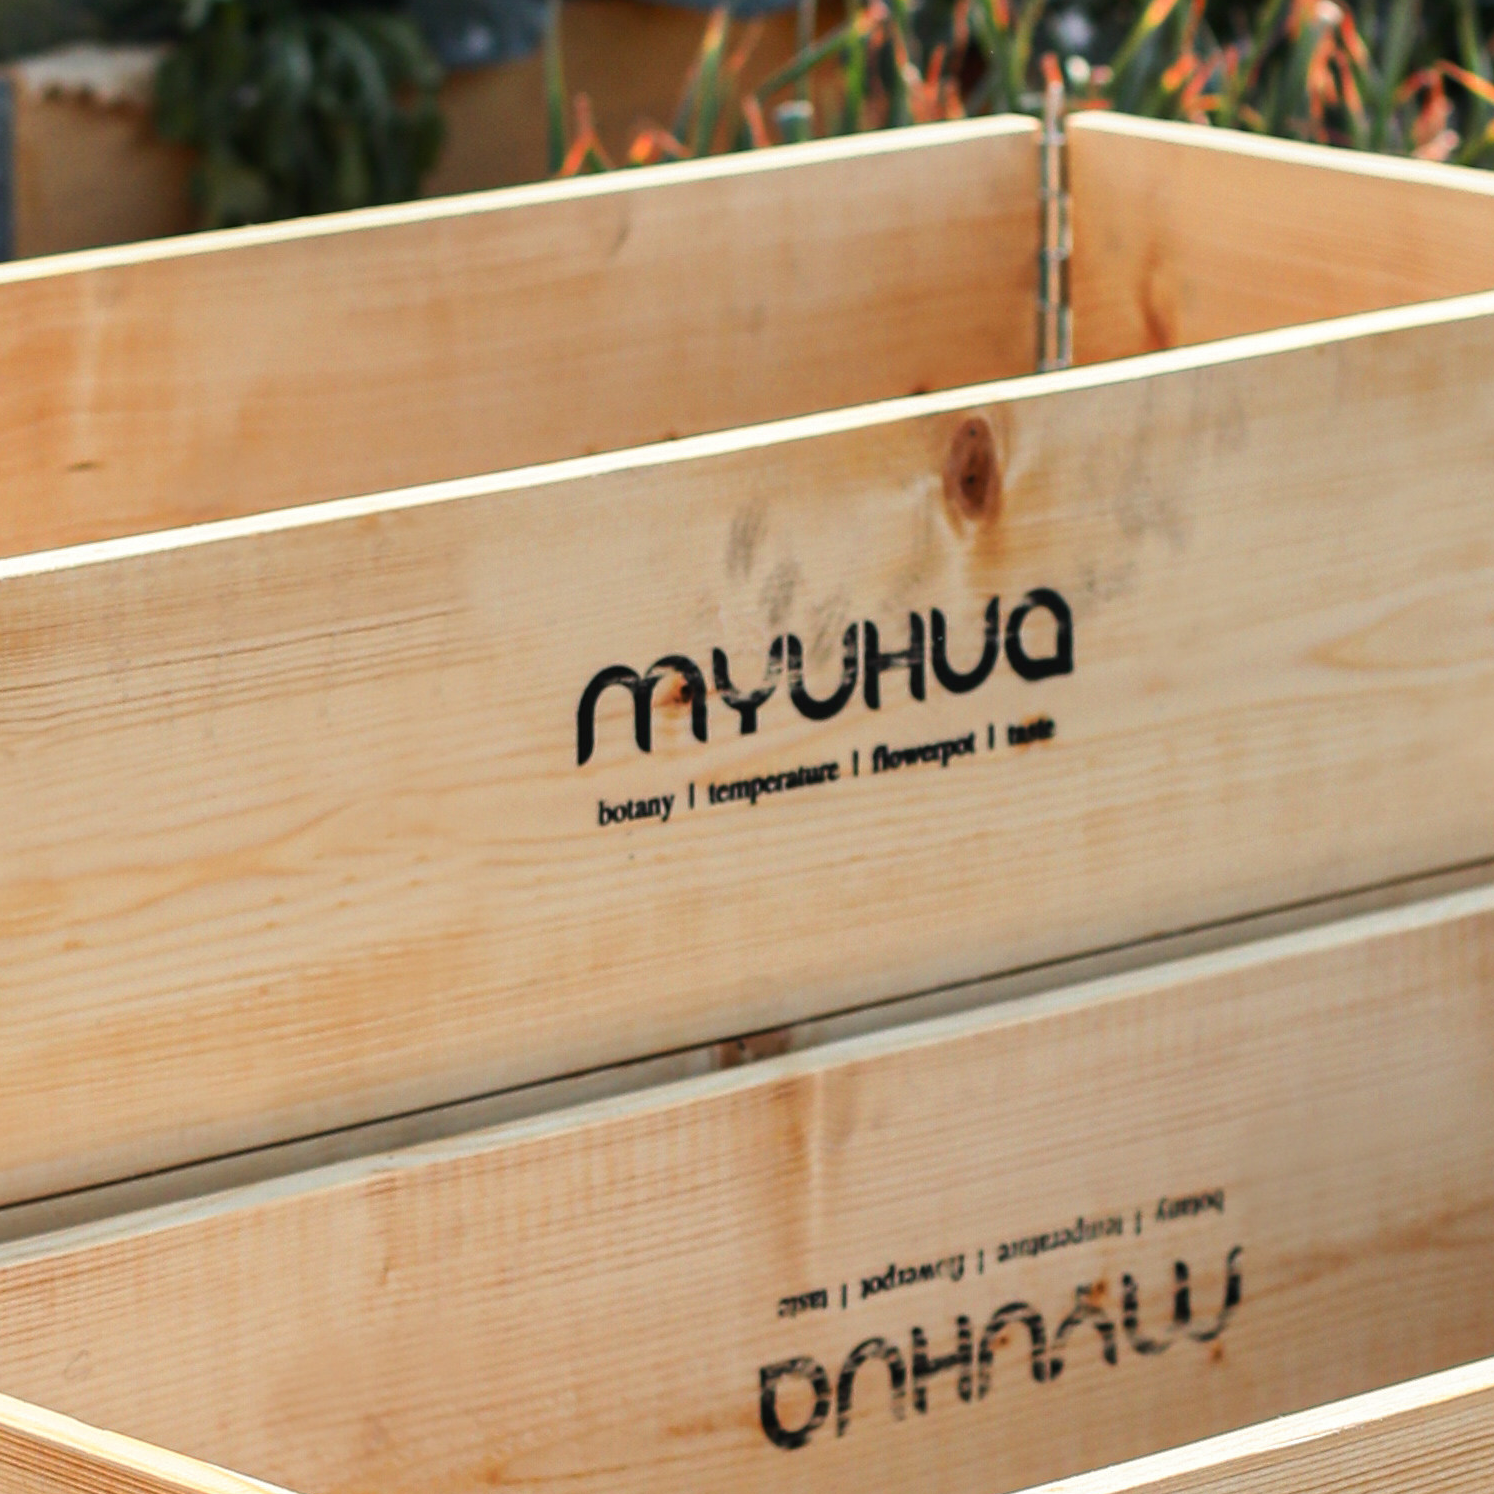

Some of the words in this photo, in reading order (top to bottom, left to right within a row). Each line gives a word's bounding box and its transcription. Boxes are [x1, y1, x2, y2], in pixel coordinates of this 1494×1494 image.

[598, 789, 675, 826] botany
[708, 762, 839, 805] temperature
[872, 731, 976, 771] flowerpot
